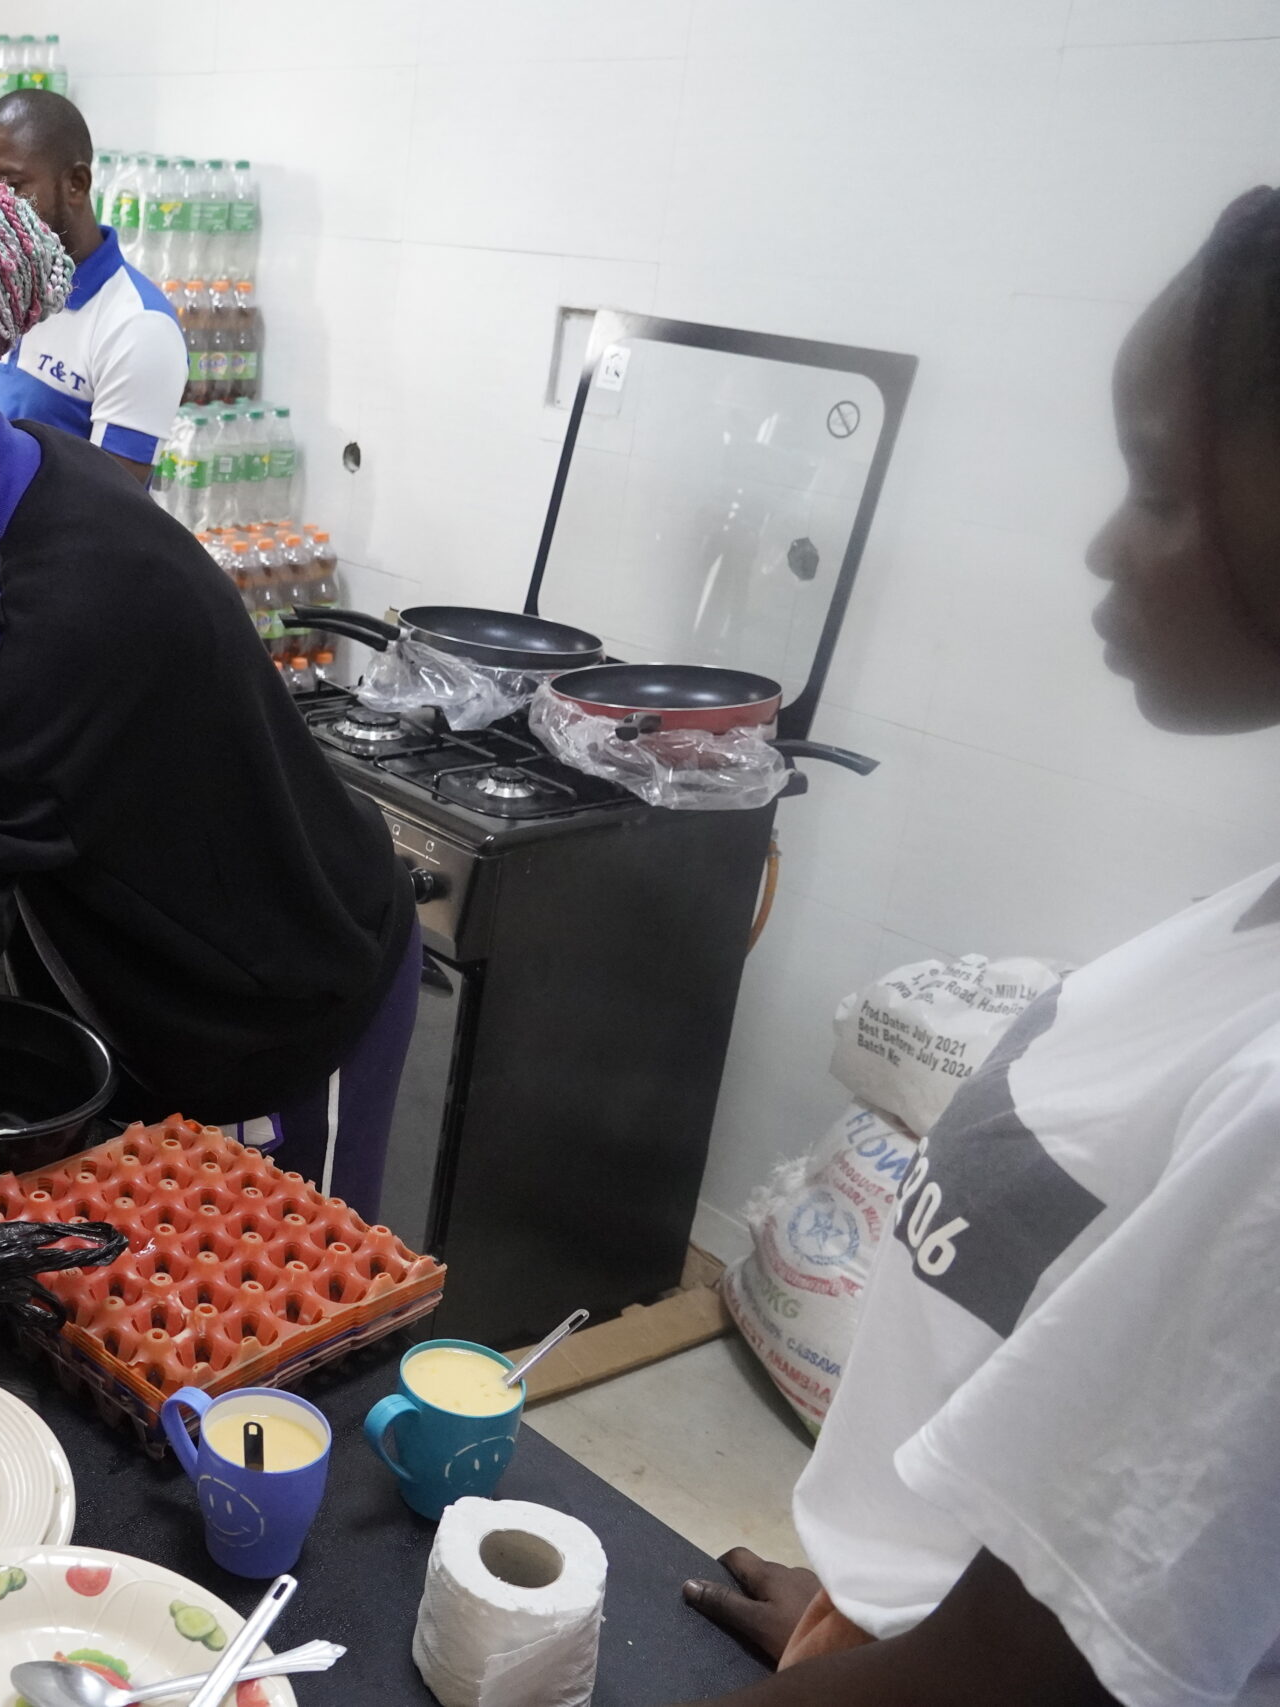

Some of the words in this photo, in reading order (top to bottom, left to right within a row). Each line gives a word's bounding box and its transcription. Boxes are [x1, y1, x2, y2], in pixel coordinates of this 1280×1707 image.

[38, 353, 86, 391] T&T
[995, 984, 1018, 999] Mill
[857, 1034, 886, 1057] Batch
[858, 1017, 880, 1039] Best
[916, 1047, 940, 1072] July
[912, 1025, 934, 1048] July
[935, 1036, 967, 1059] 2021
[786, 1336, 842, 1378] CASSAVA
